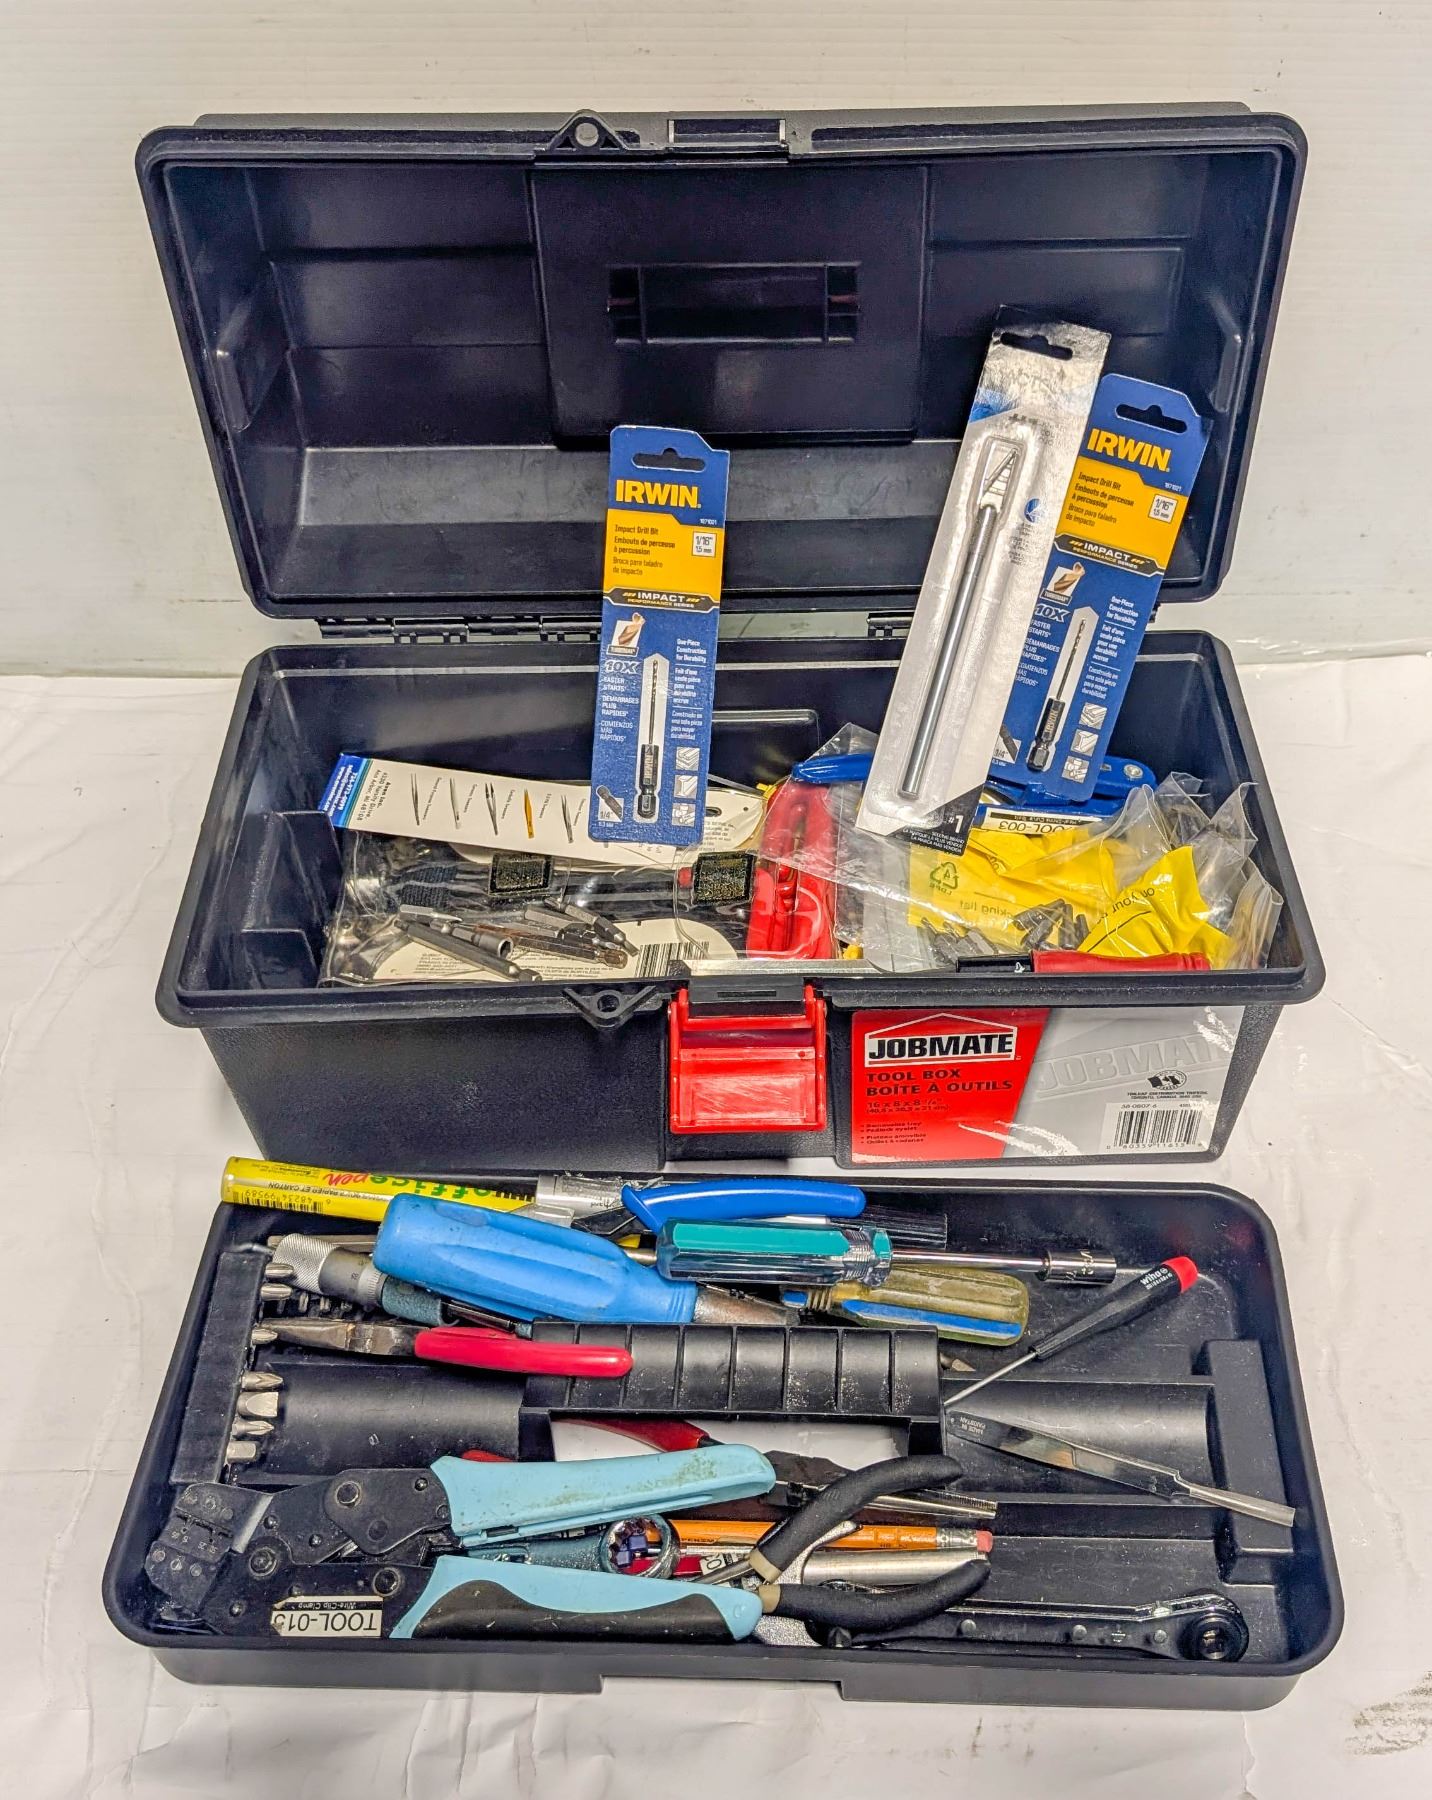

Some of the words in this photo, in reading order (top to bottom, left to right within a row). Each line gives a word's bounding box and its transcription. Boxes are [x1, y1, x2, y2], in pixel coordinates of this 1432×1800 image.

[1087, 428, 1171, 472] IRWIN
[1079, 471, 1099, 485] Impact
[1099, 476, 1112, 488] Drill
[615, 480, 701, 508] IRWIN
[1074, 483, 1099, 498] Embouts
[615, 524, 636, 534] Impact
[1083, 542, 1131, 562] IMPACT
[637, 592, 685, 603] IMPACT
[1035, 603, 1070, 622] 10X
[605, 660, 640, 674] 10X
[999, 820, 1072, 834] OOL-003
[868, 1033, 1014, 1060] JOBMATE
[866, 1071, 916, 1083] TOOL
[922, 1069, 961, 1080] BOX
[866, 1084, 921, 1097] BOÎTE
[927, 1082, 940, 1093] À
[947, 1080, 1013, 1092] OUTILS
